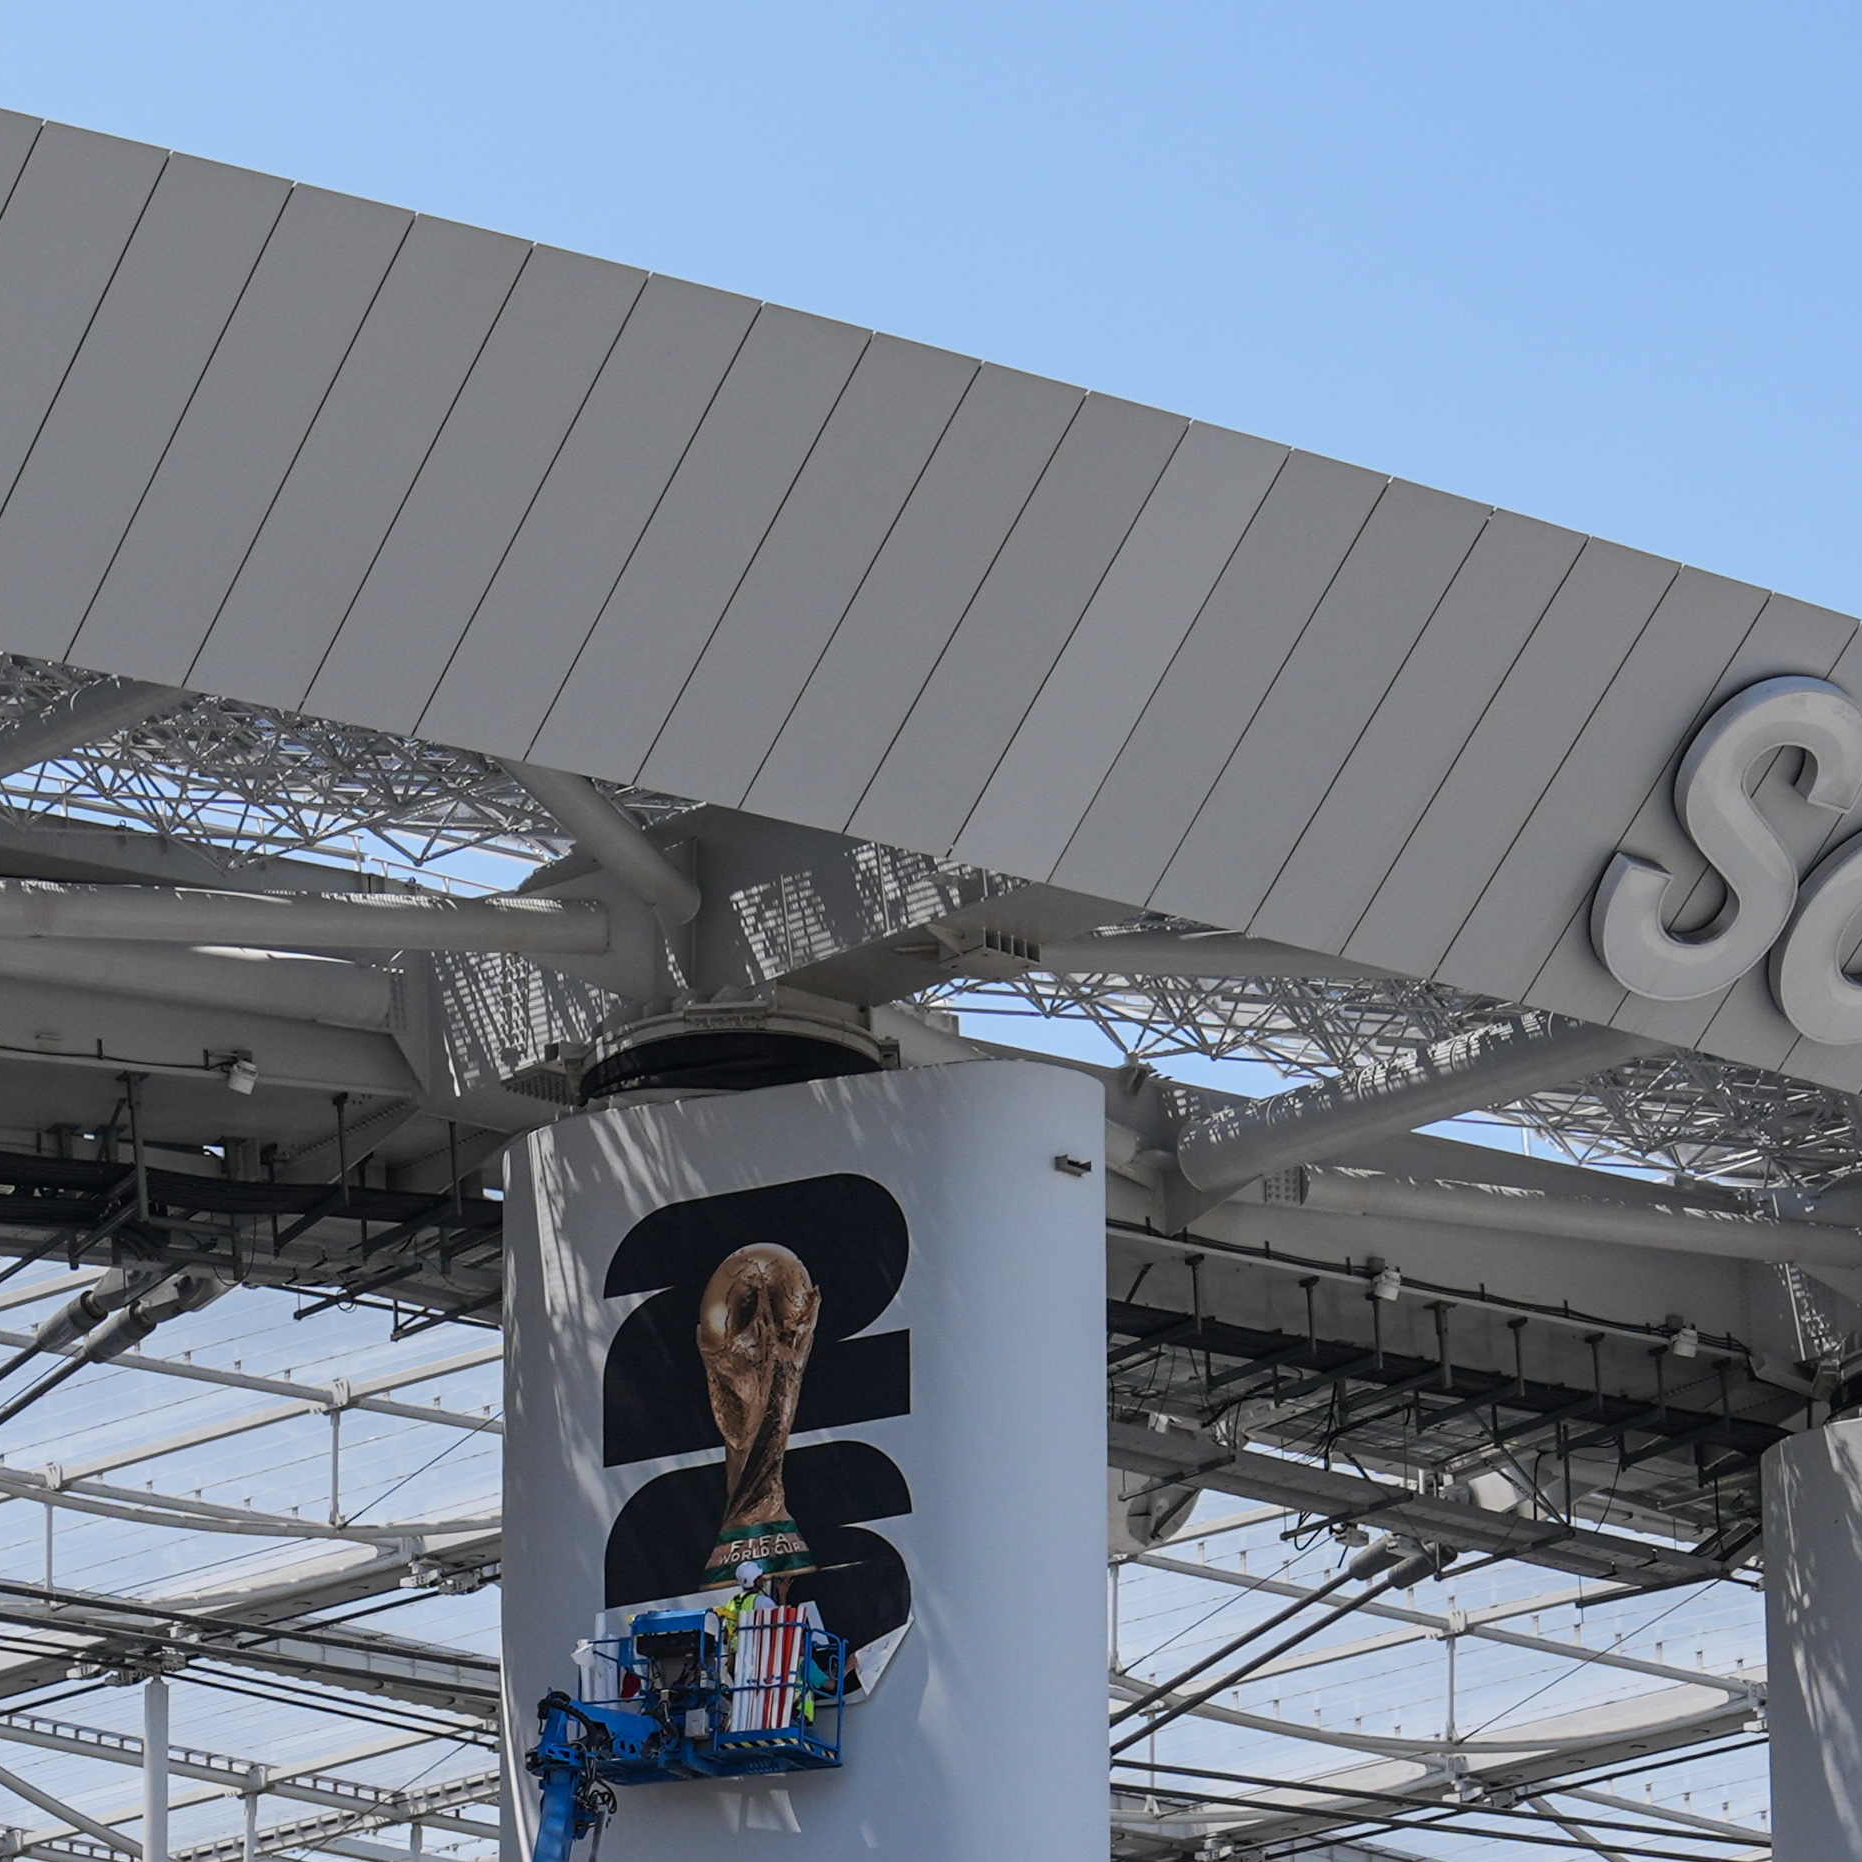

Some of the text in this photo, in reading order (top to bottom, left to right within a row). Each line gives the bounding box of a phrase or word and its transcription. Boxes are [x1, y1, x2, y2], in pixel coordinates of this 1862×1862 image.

[719, 1541, 802, 1565] WORLD CUP
[730, 1532, 788, 1553] FIFA
